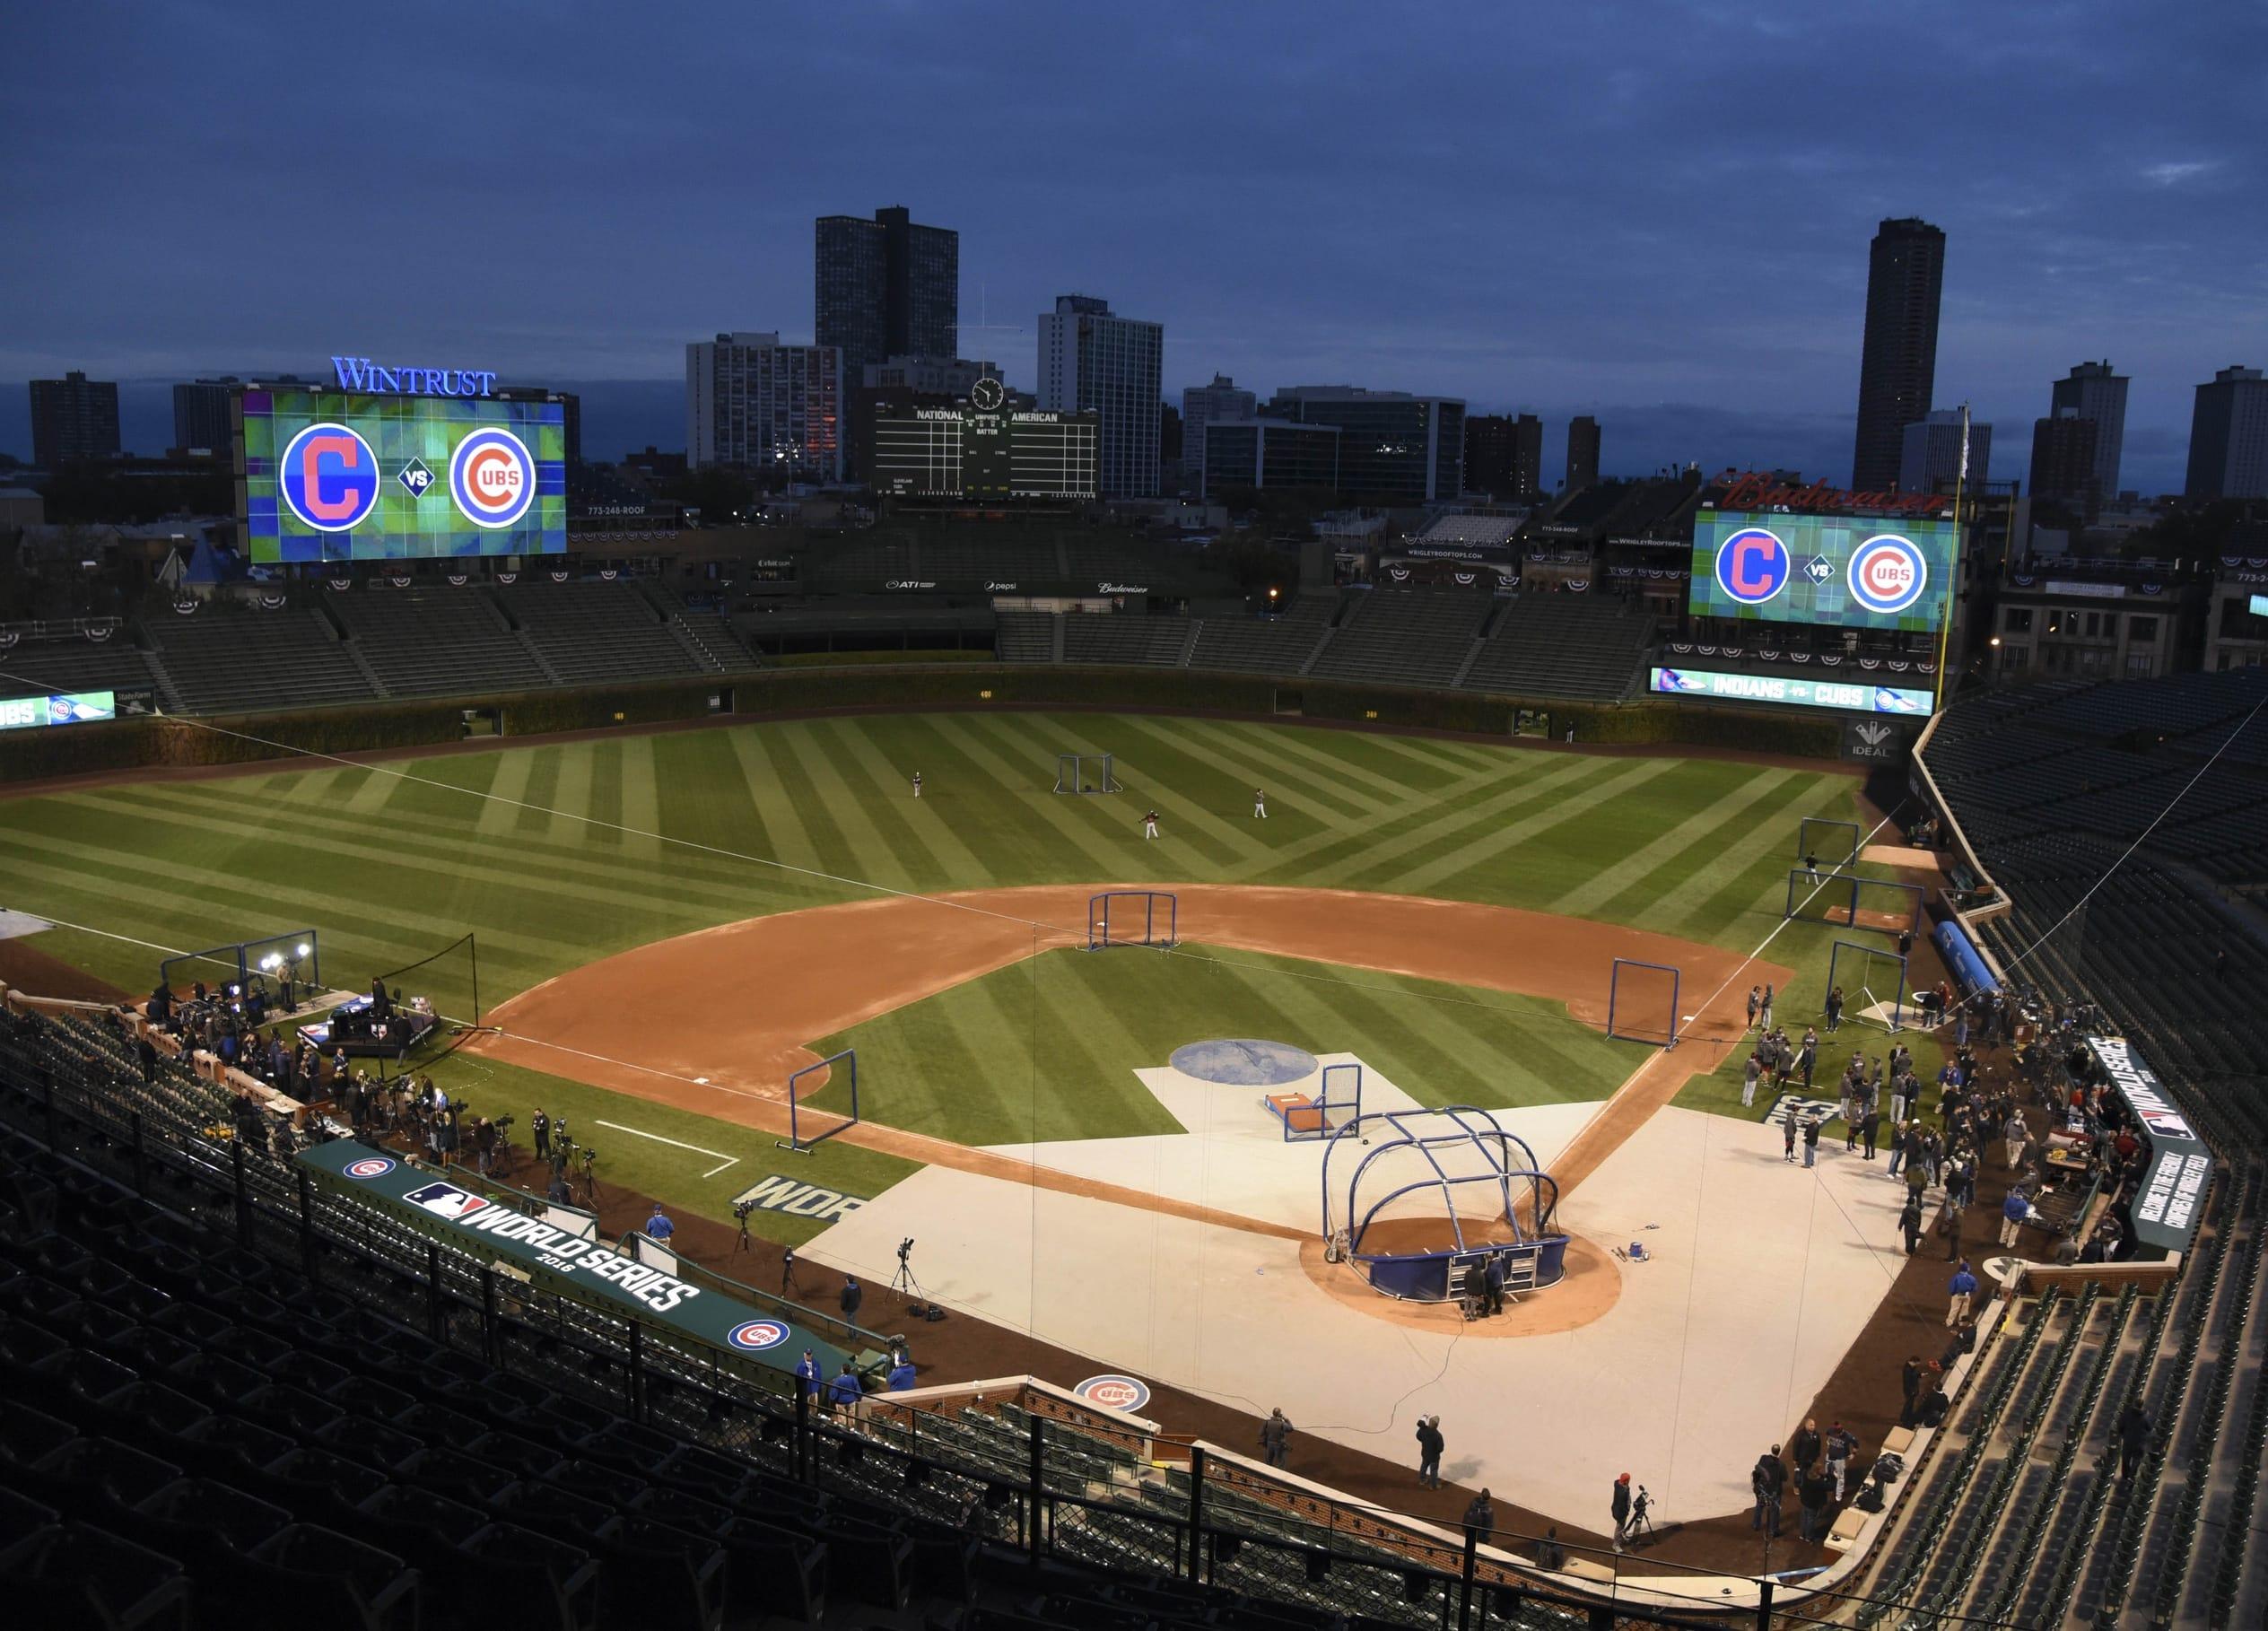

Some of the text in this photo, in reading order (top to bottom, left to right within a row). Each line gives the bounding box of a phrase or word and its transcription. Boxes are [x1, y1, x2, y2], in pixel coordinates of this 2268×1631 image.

[330, 356, 496, 397] WINTRUST
[917, 410, 964, 420] NATIONAL
[1011, 413, 1058, 423] AMERICAN
[303, 435, 359, 520] C
[1712, 472, 1953, 511] Budweiser
[588, 506, 646, 516] 773-248-ROOF
[1732, 536, 1775, 596] C
[899, 580, 919, 589] ATI
[995, 582, 1016, 590] pepsi
[1097, 582, 1148, 593] Budweiser
[1713, 676, 1785, 700] INDIANS
[1814, 685, 1863, 706] CUBS
[1853, 746, 1890, 758] IDEAL
[2111, 1070, 2176, 1113] WORLD
[459, 1204, 701, 1313] WORLD SERIES
[535, 1253, 577, 1273] 2016
